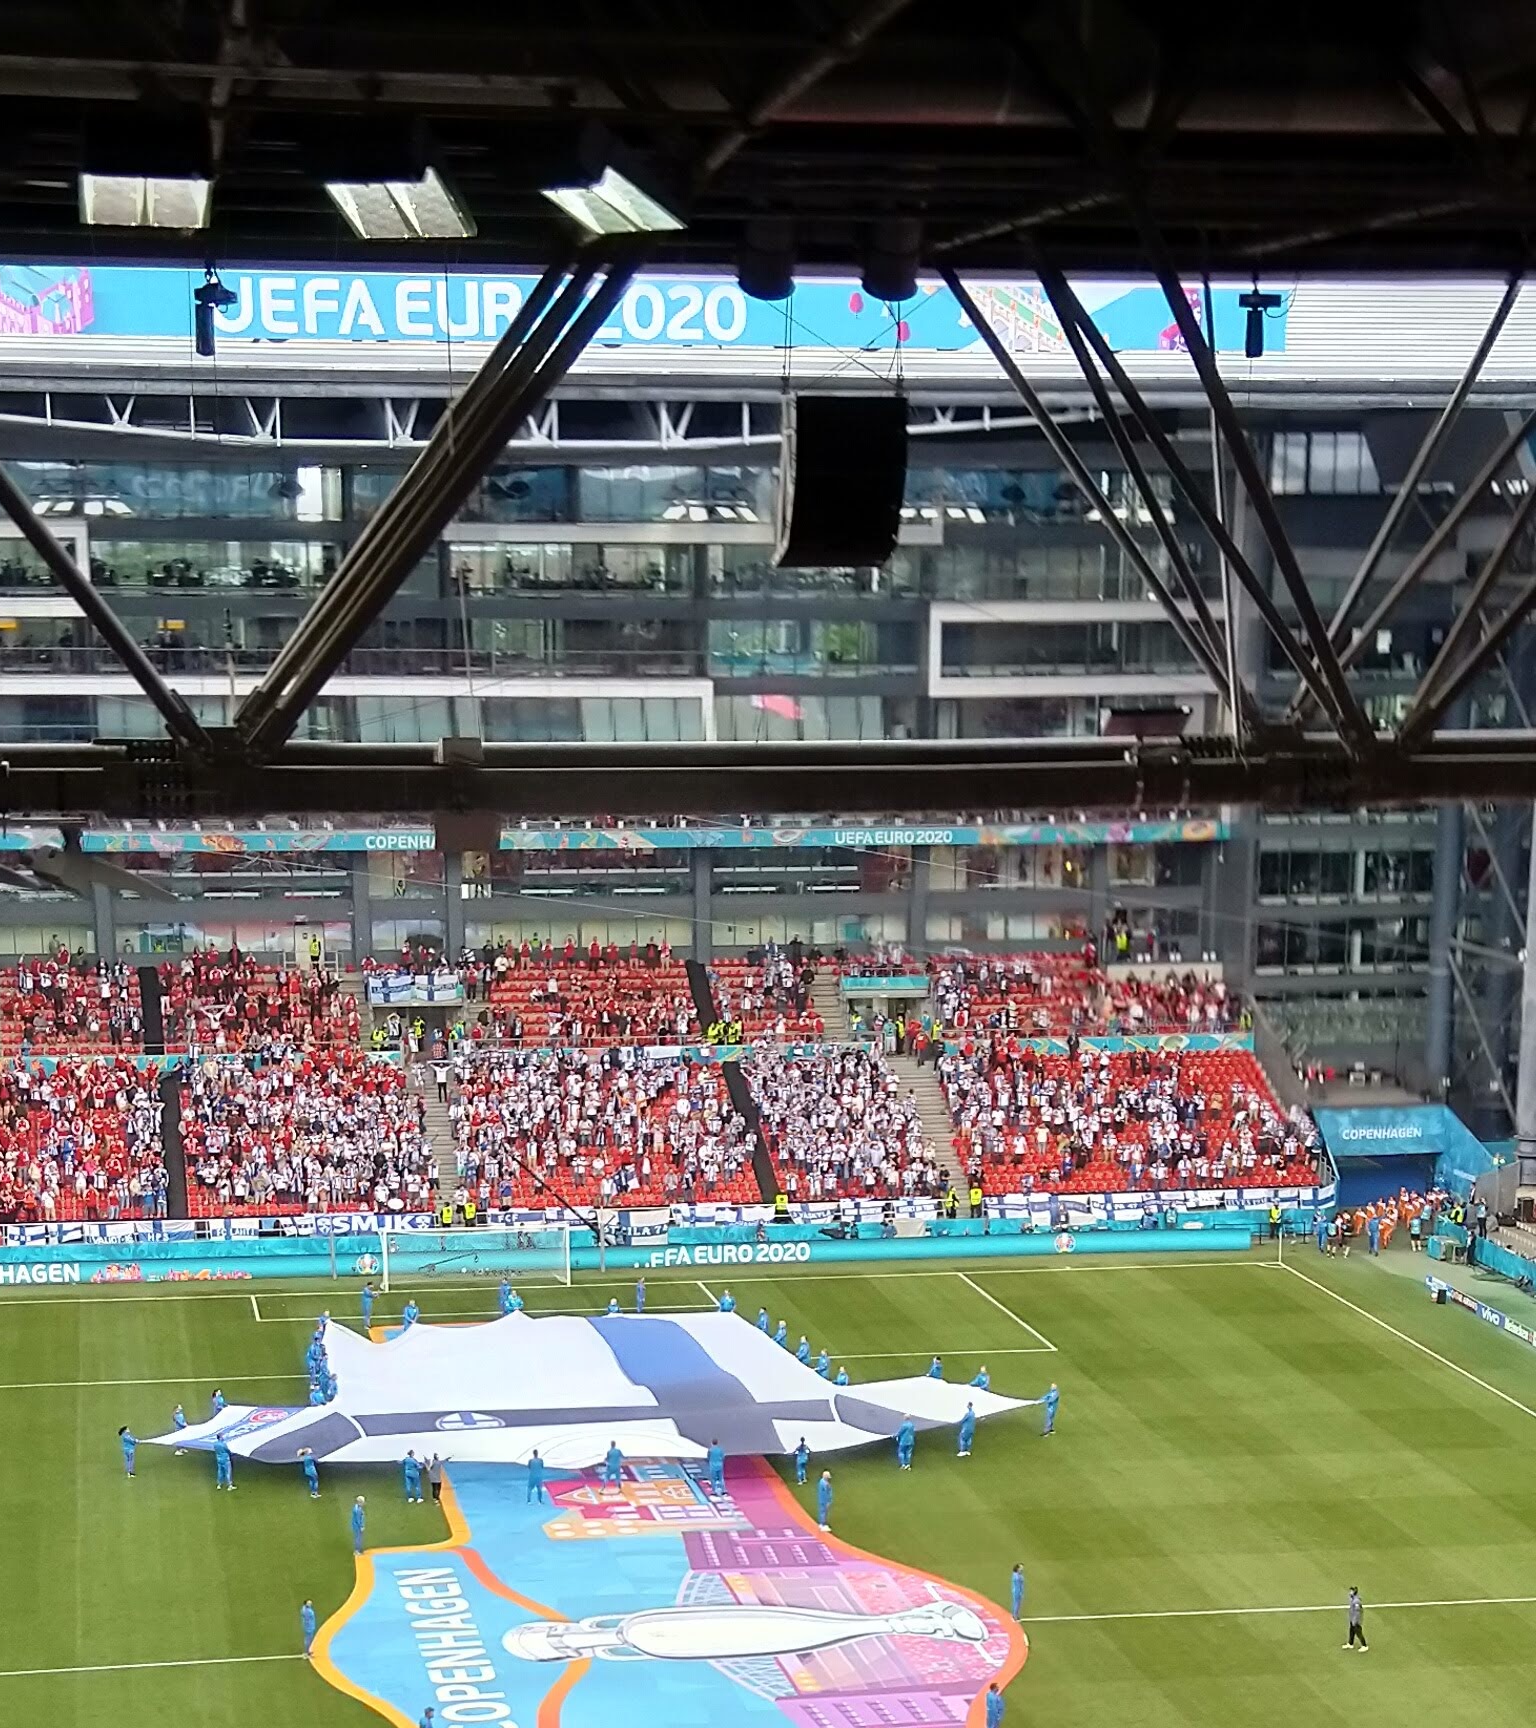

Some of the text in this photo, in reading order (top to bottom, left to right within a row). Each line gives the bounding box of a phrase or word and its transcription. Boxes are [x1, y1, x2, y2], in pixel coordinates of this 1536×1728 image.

[213, 276, 385, 335] UEFA
[396, 279, 524, 337] EUR
[365, 835, 435, 850] COPENH
[835, 830, 952, 845] UEFA EURO 2020
[1342, 1127, 1423, 1140] COPENHAGEN
[634, 1242, 811, 1269] EFA EURO 2020
